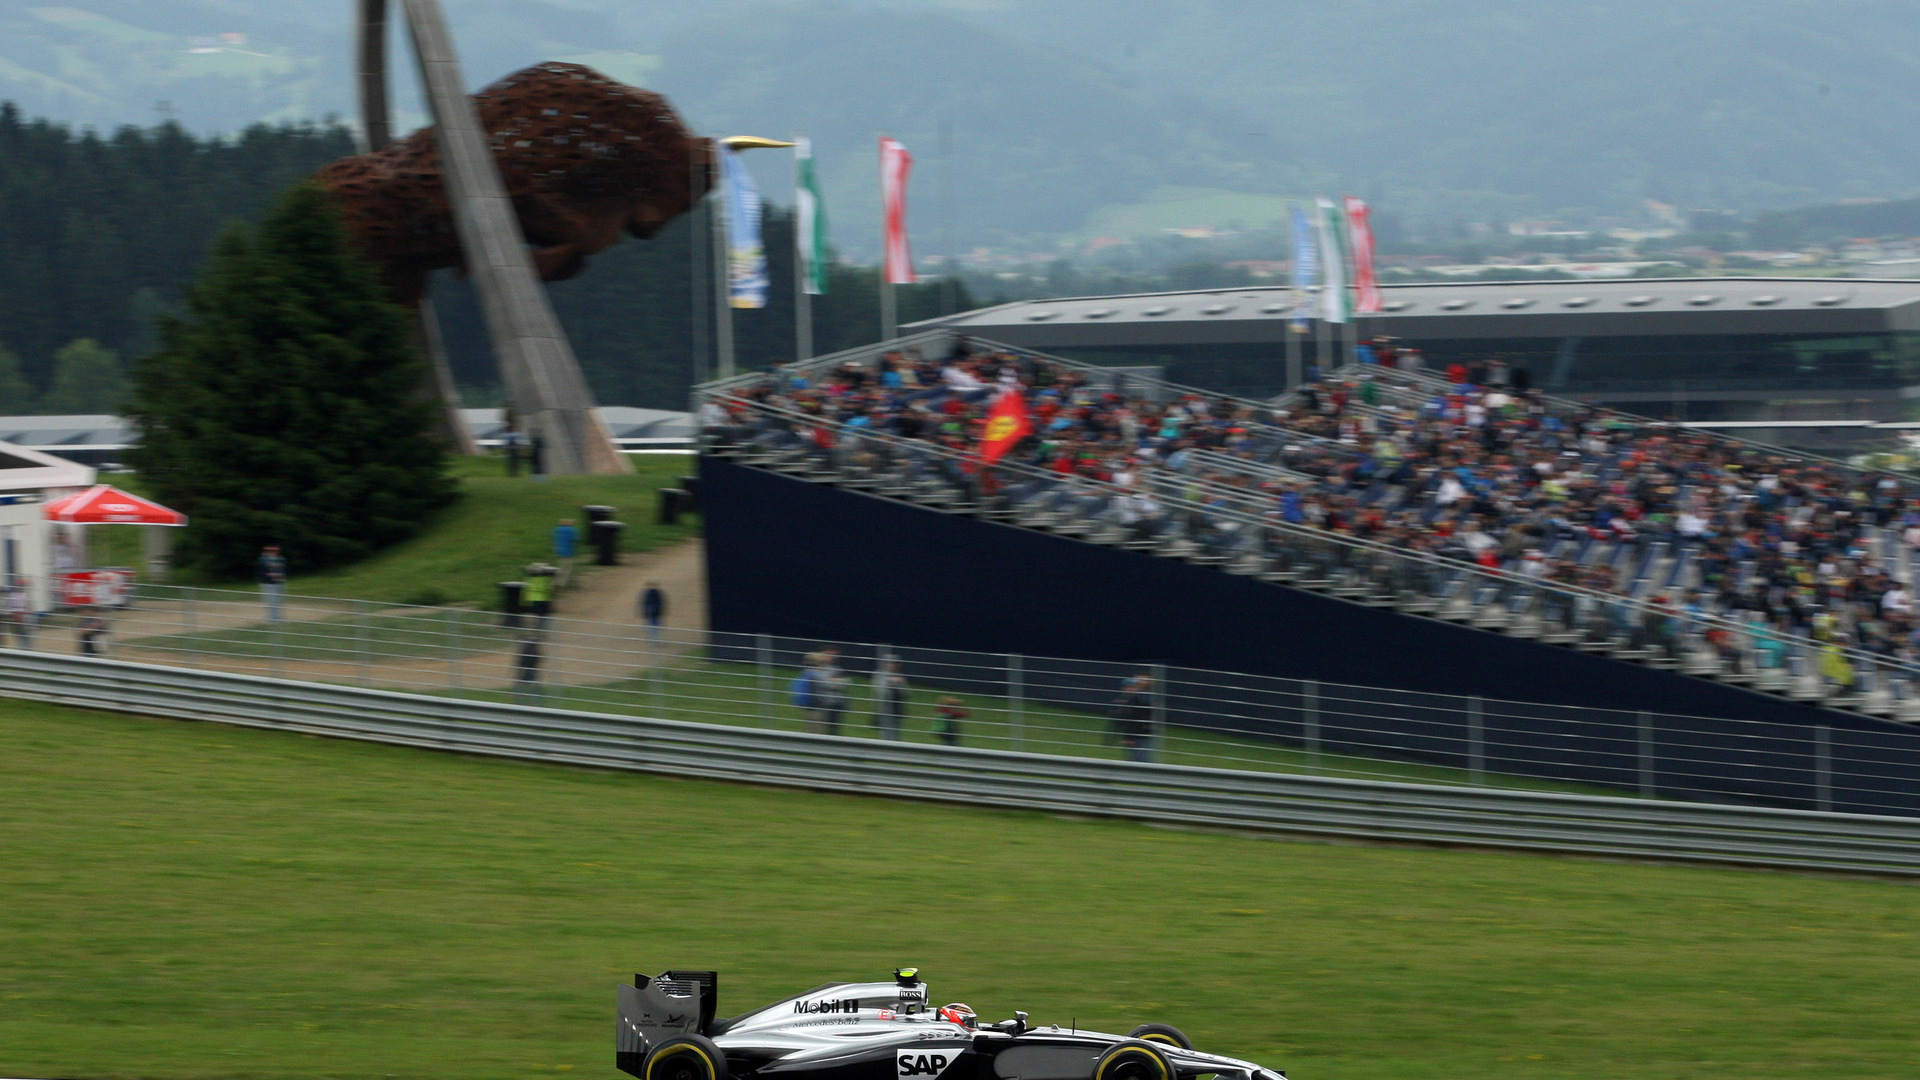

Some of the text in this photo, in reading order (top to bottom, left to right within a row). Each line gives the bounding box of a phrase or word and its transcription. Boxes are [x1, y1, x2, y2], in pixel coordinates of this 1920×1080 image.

[794, 999, 855, 1014] Mobil 1
[899, 1055, 947, 1076] SAP
